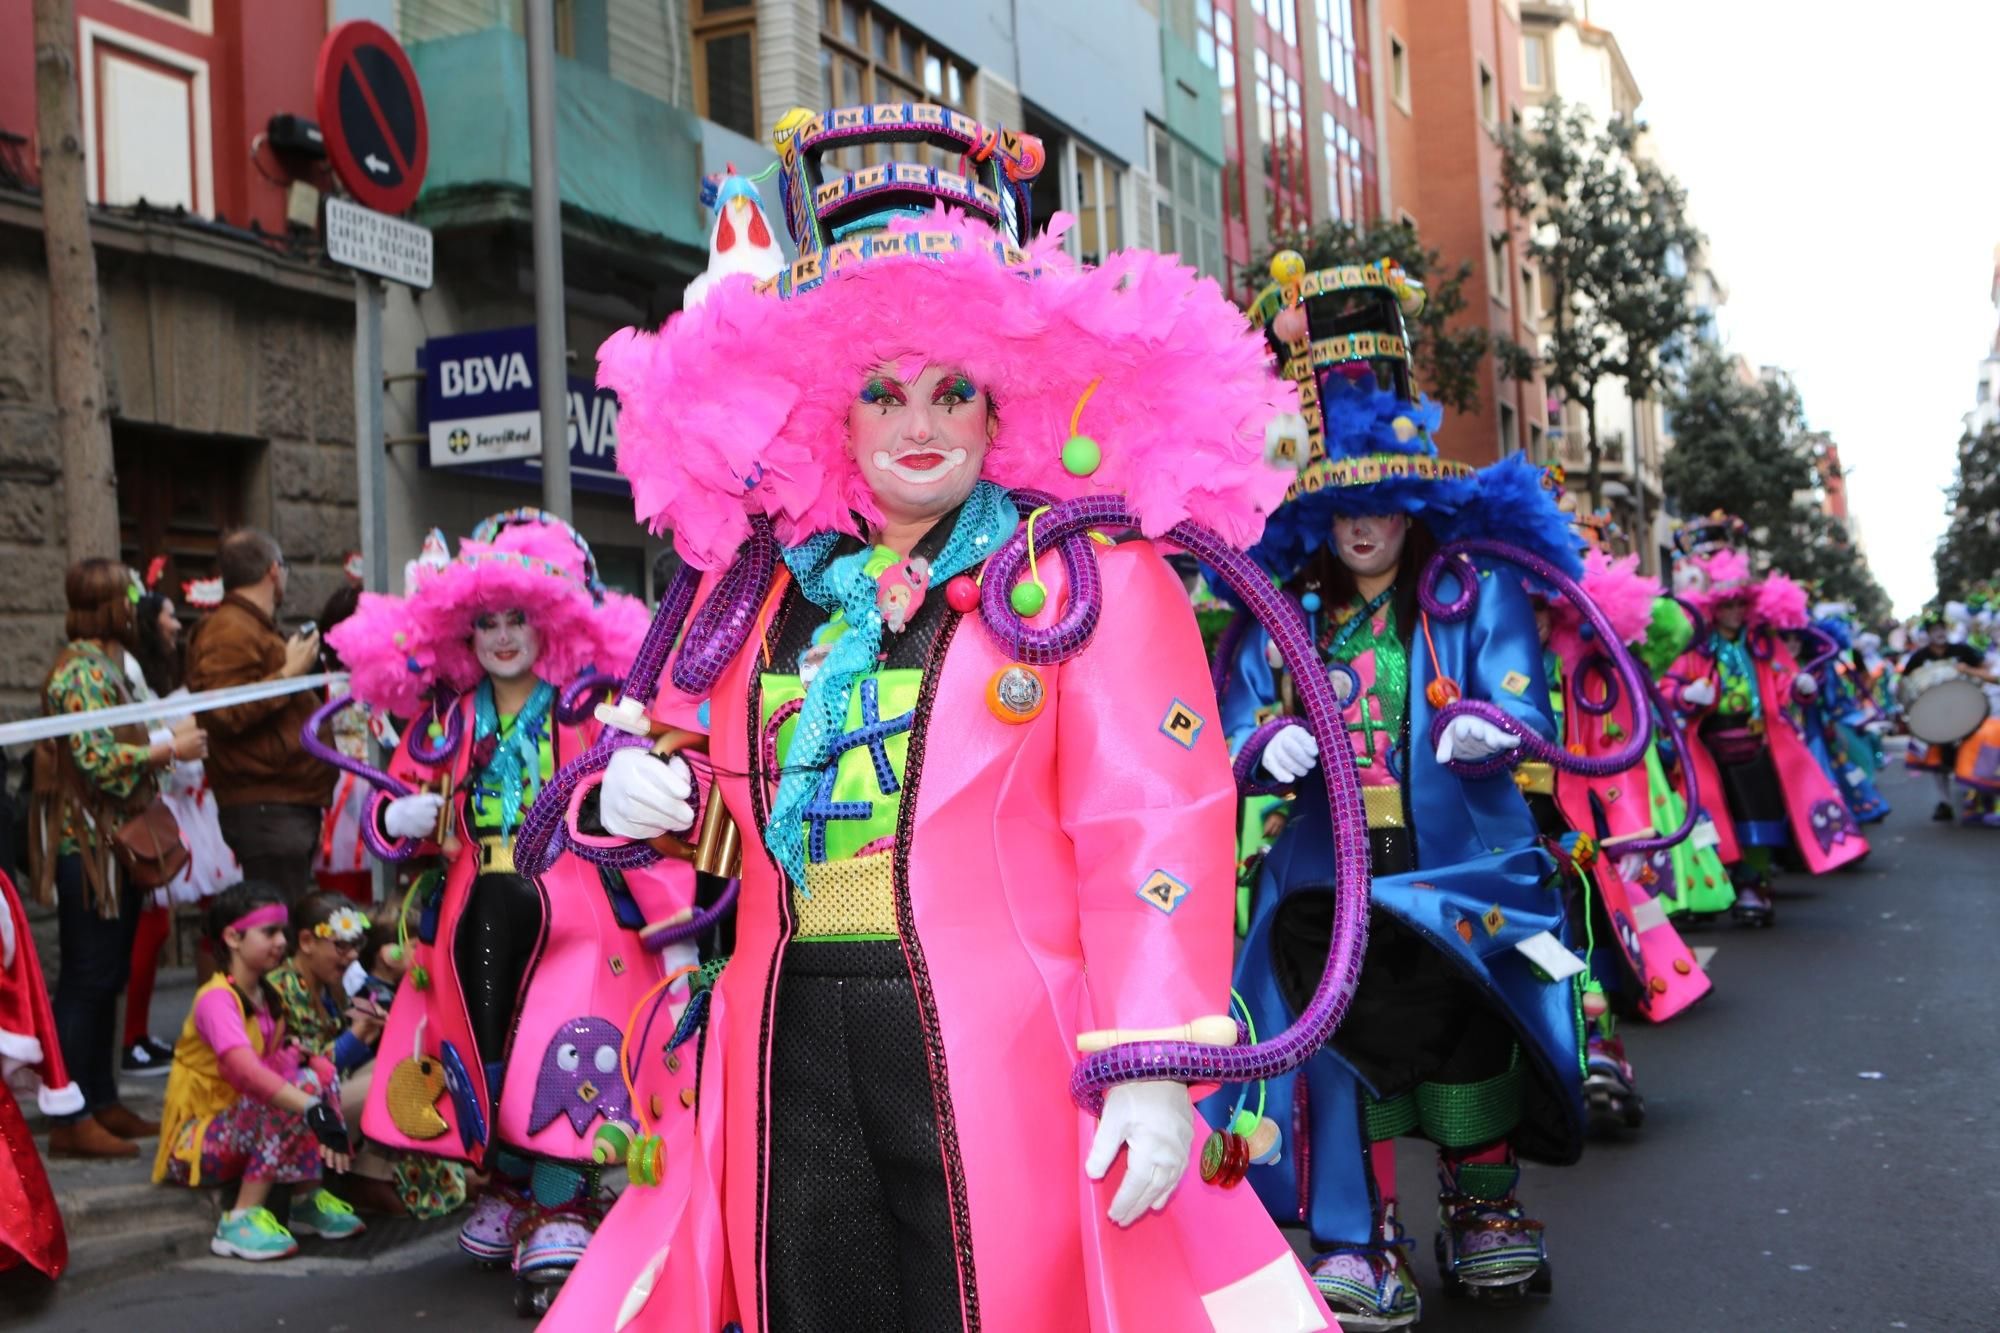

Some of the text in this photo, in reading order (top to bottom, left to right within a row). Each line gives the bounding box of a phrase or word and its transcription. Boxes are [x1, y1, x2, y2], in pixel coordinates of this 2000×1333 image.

[332, 204, 427, 248] EXCEPTO FESTIVOS
[331, 222, 364, 244] CARGA
[379, 237, 428, 264] DESCARGA
[440, 352, 533, 398] BBVA
[475, 427, 531, 447] ServiRed
[1170, 711, 1192, 731] P
[1148, 882, 1172, 903] A
